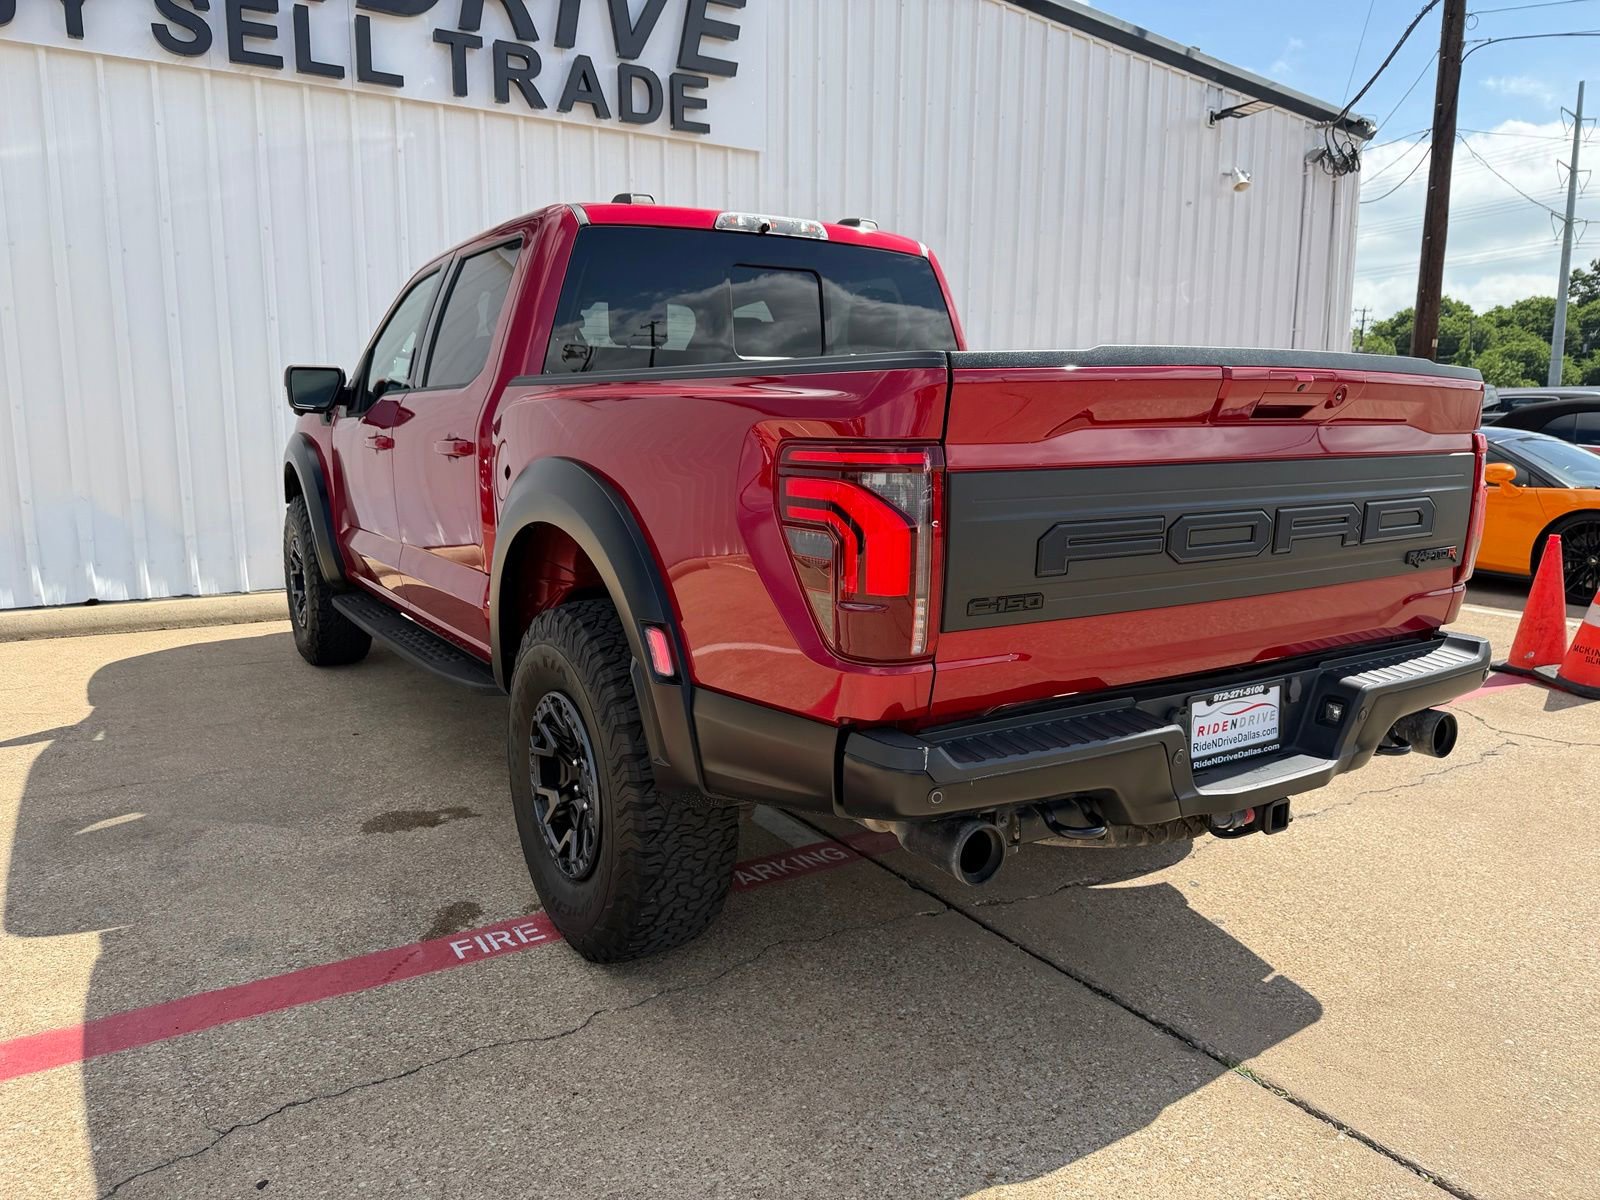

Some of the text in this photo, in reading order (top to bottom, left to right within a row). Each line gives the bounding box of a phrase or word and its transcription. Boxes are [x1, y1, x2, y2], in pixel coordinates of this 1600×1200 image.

[152, 0, 404, 88] SELL
[433, 28, 711, 134] TRADE
[1036, 496, 1438, 578] FORD
[967, 592, 1044, 616] F-150
[1213, 685, 1265, 702] 972-271-5100
[1192, 726, 1278, 753] RideNDriveDallas.com
[1193, 743, 1280, 769] RideNDriveDallas.com
[449, 847, 849, 959] FIRE ARKING
